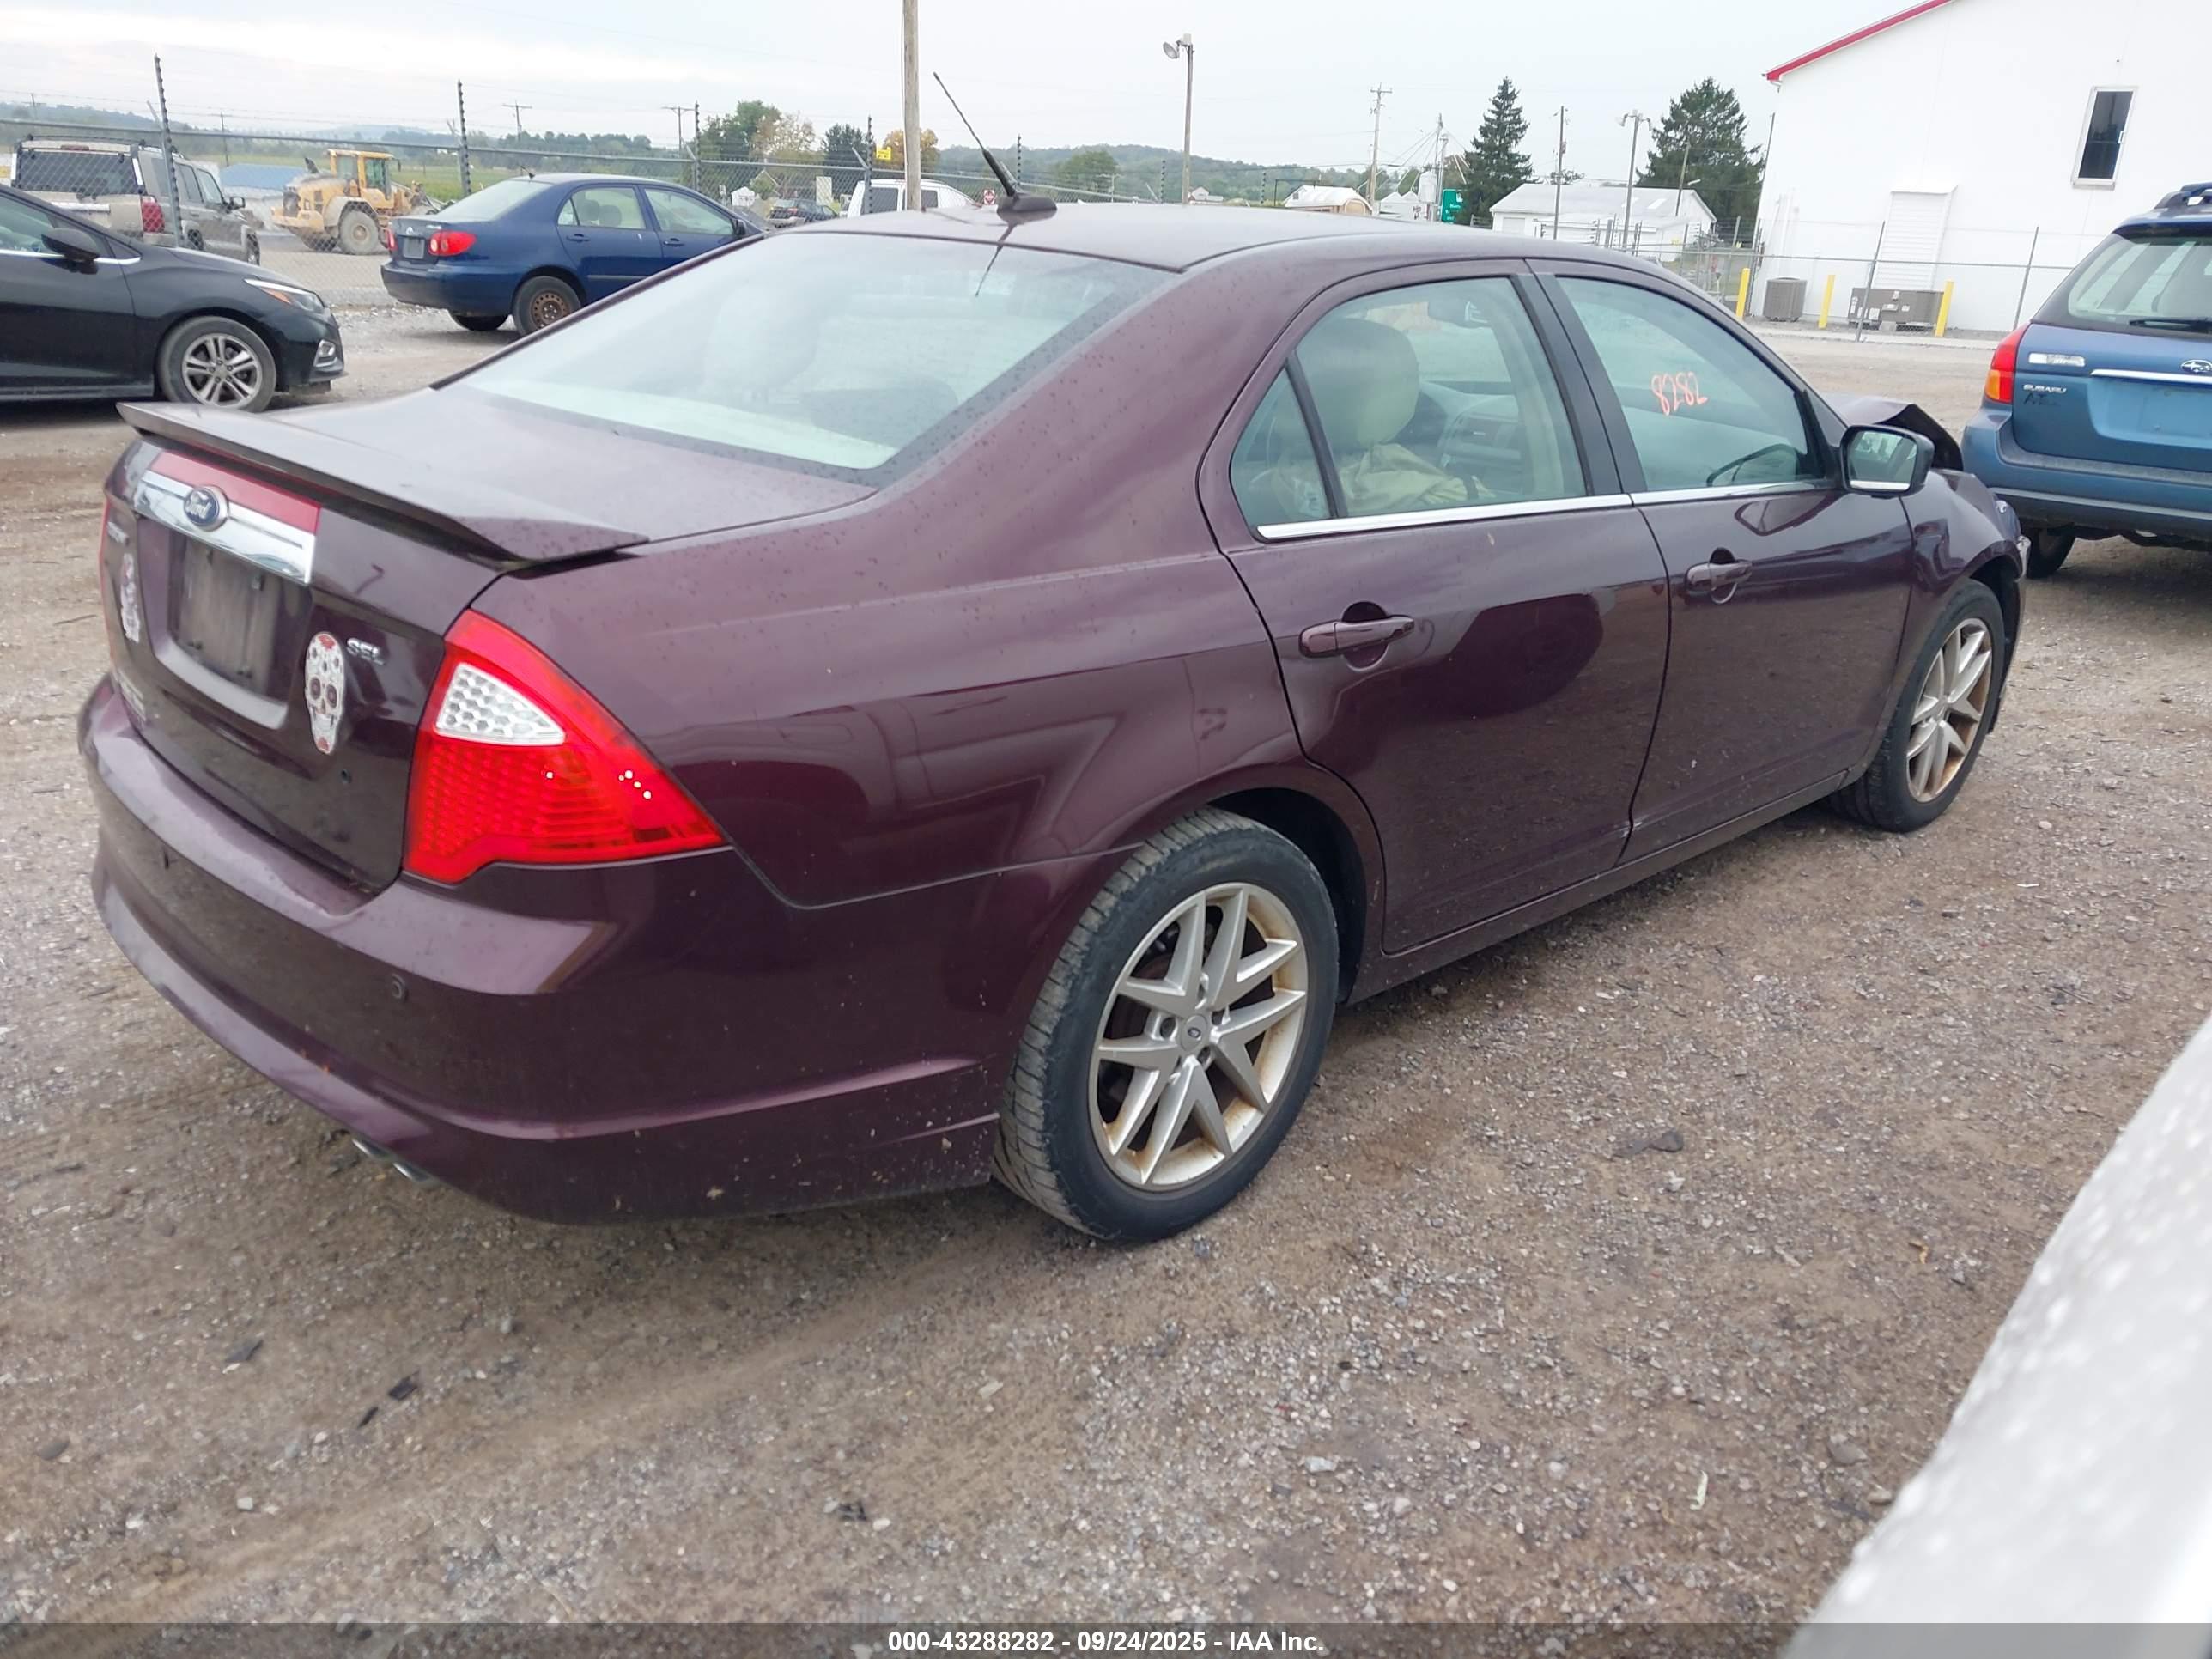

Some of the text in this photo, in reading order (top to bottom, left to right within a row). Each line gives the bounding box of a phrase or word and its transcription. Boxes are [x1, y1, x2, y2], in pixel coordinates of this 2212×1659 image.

[1651, 371, 1709, 416] 8282
[2023, 384, 2067, 393] SUBARU
[185, 490, 212, 519] Ford
[347, 638, 384, 665] SEL
